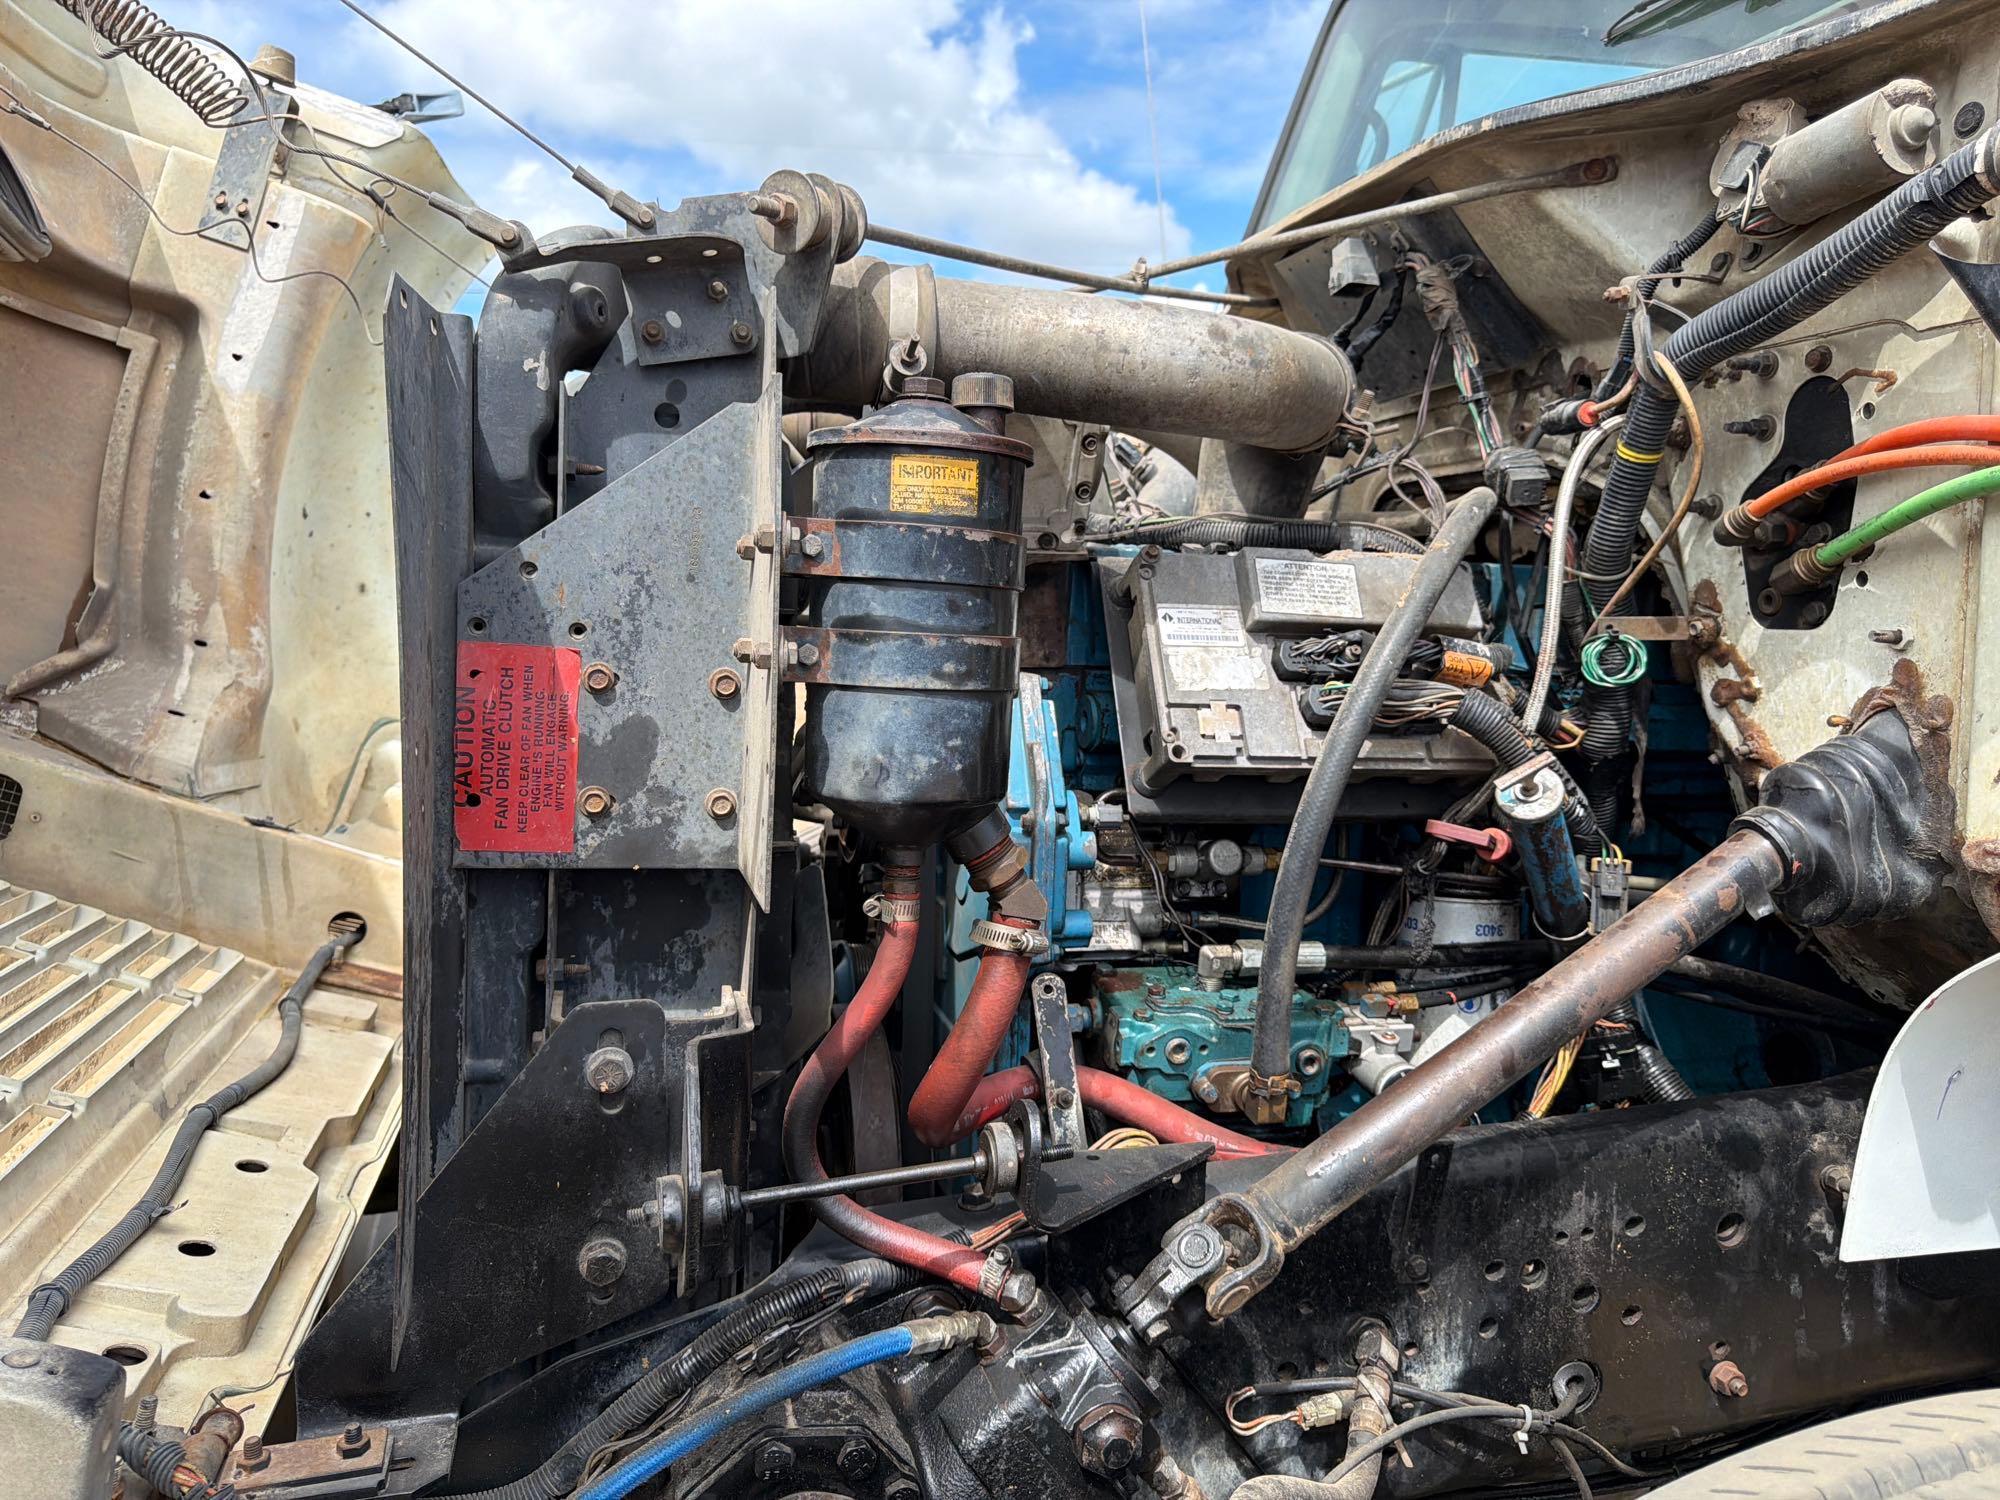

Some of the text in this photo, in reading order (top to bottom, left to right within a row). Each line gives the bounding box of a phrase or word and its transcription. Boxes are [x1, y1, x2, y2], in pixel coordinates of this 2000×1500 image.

[897, 464, 974, 482] IMPORTANT
[1284, 563, 1327, 571] ATTENTION
[454, 686, 476, 808] CAUTION
[479, 699, 497, 797] AUTOMATIC
[494, 667, 514, 830] FAN DRIVE CLUTCH
[517, 665, 534, 833] KEEP CLEAR OF FAN WHEN
[530, 688, 545, 813] ENGINE IS RUNNING.
[543, 694, 557, 807] FAN WILL ENGAGE
[555, 690, 570, 812] WITHOUT WARNING.
[1475, 924, 1504, 937] 3403
